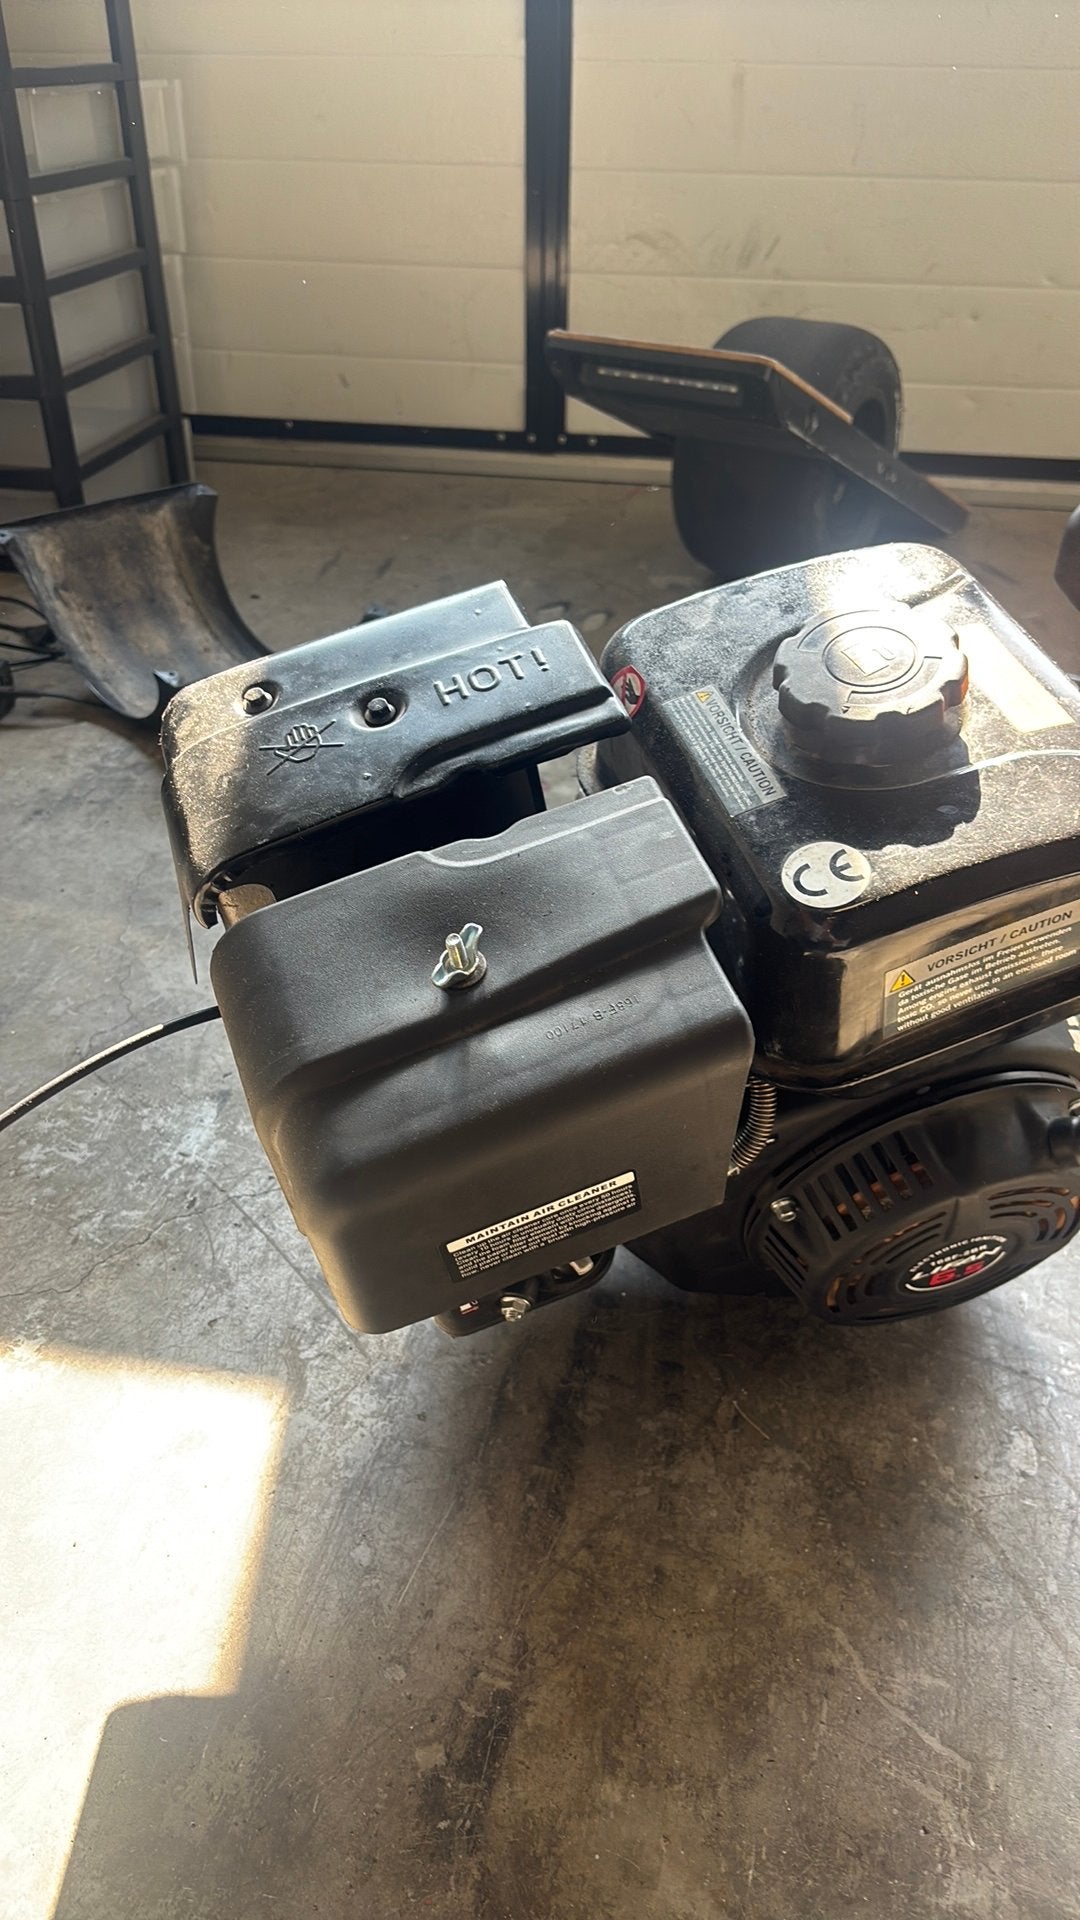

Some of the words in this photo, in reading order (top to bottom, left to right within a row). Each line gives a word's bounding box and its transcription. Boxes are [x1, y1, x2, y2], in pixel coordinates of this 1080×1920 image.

[433, 647, 550, 706] HOT!
[705, 698, 743, 746] VORSICHT
[739, 751, 776, 796] CAUTION
[793, 848, 865, 896] CE
[927, 938, 997, 972] VORSICHT
[1010, 909, 1072, 940] CAUTION
[996, 945, 1023, 960] Freien
[1026, 927, 1071, 948] verwenden
[897, 1011, 917, 1022] toxic
[949, 989, 972, 1002] never
[974, 983, 989, 992] use
[1002, 973, 1013, 981] an
[1054, 949, 1076, 961] room
[897, 999, 926, 1014] Among
[928, 987, 957, 1002] engine
[959, 972, 991, 990] exhaust
[911, 983, 945, 1001] toxische
[947, 974, 968, 986] Gase
[971, 969, 982, 977] im
[984, 954, 1016, 971] Betrieb
[896, 1013, 928, 1031] without
[930, 1004, 950, 1019] good
[452, 1246, 475, 1257] Clean
[487, 1236, 500, 1244] the
[512, 1220, 540, 1234] cleaner
[610, 1184, 632, 1195] hours
[465, 1214, 529, 1243] MAINTAIN
[532, 1204, 555, 1217] AIR
[557, 1179, 617, 1207] CLEANER
[558, 1226, 574, 1235] with
[456, 1255, 478, 1265] Clean
[458, 1261, 472, 1269] and
[486, 1248, 508, 1259] paper
[489, 1237, 511, 1248] hours
[523, 1245, 538, 1253] with
